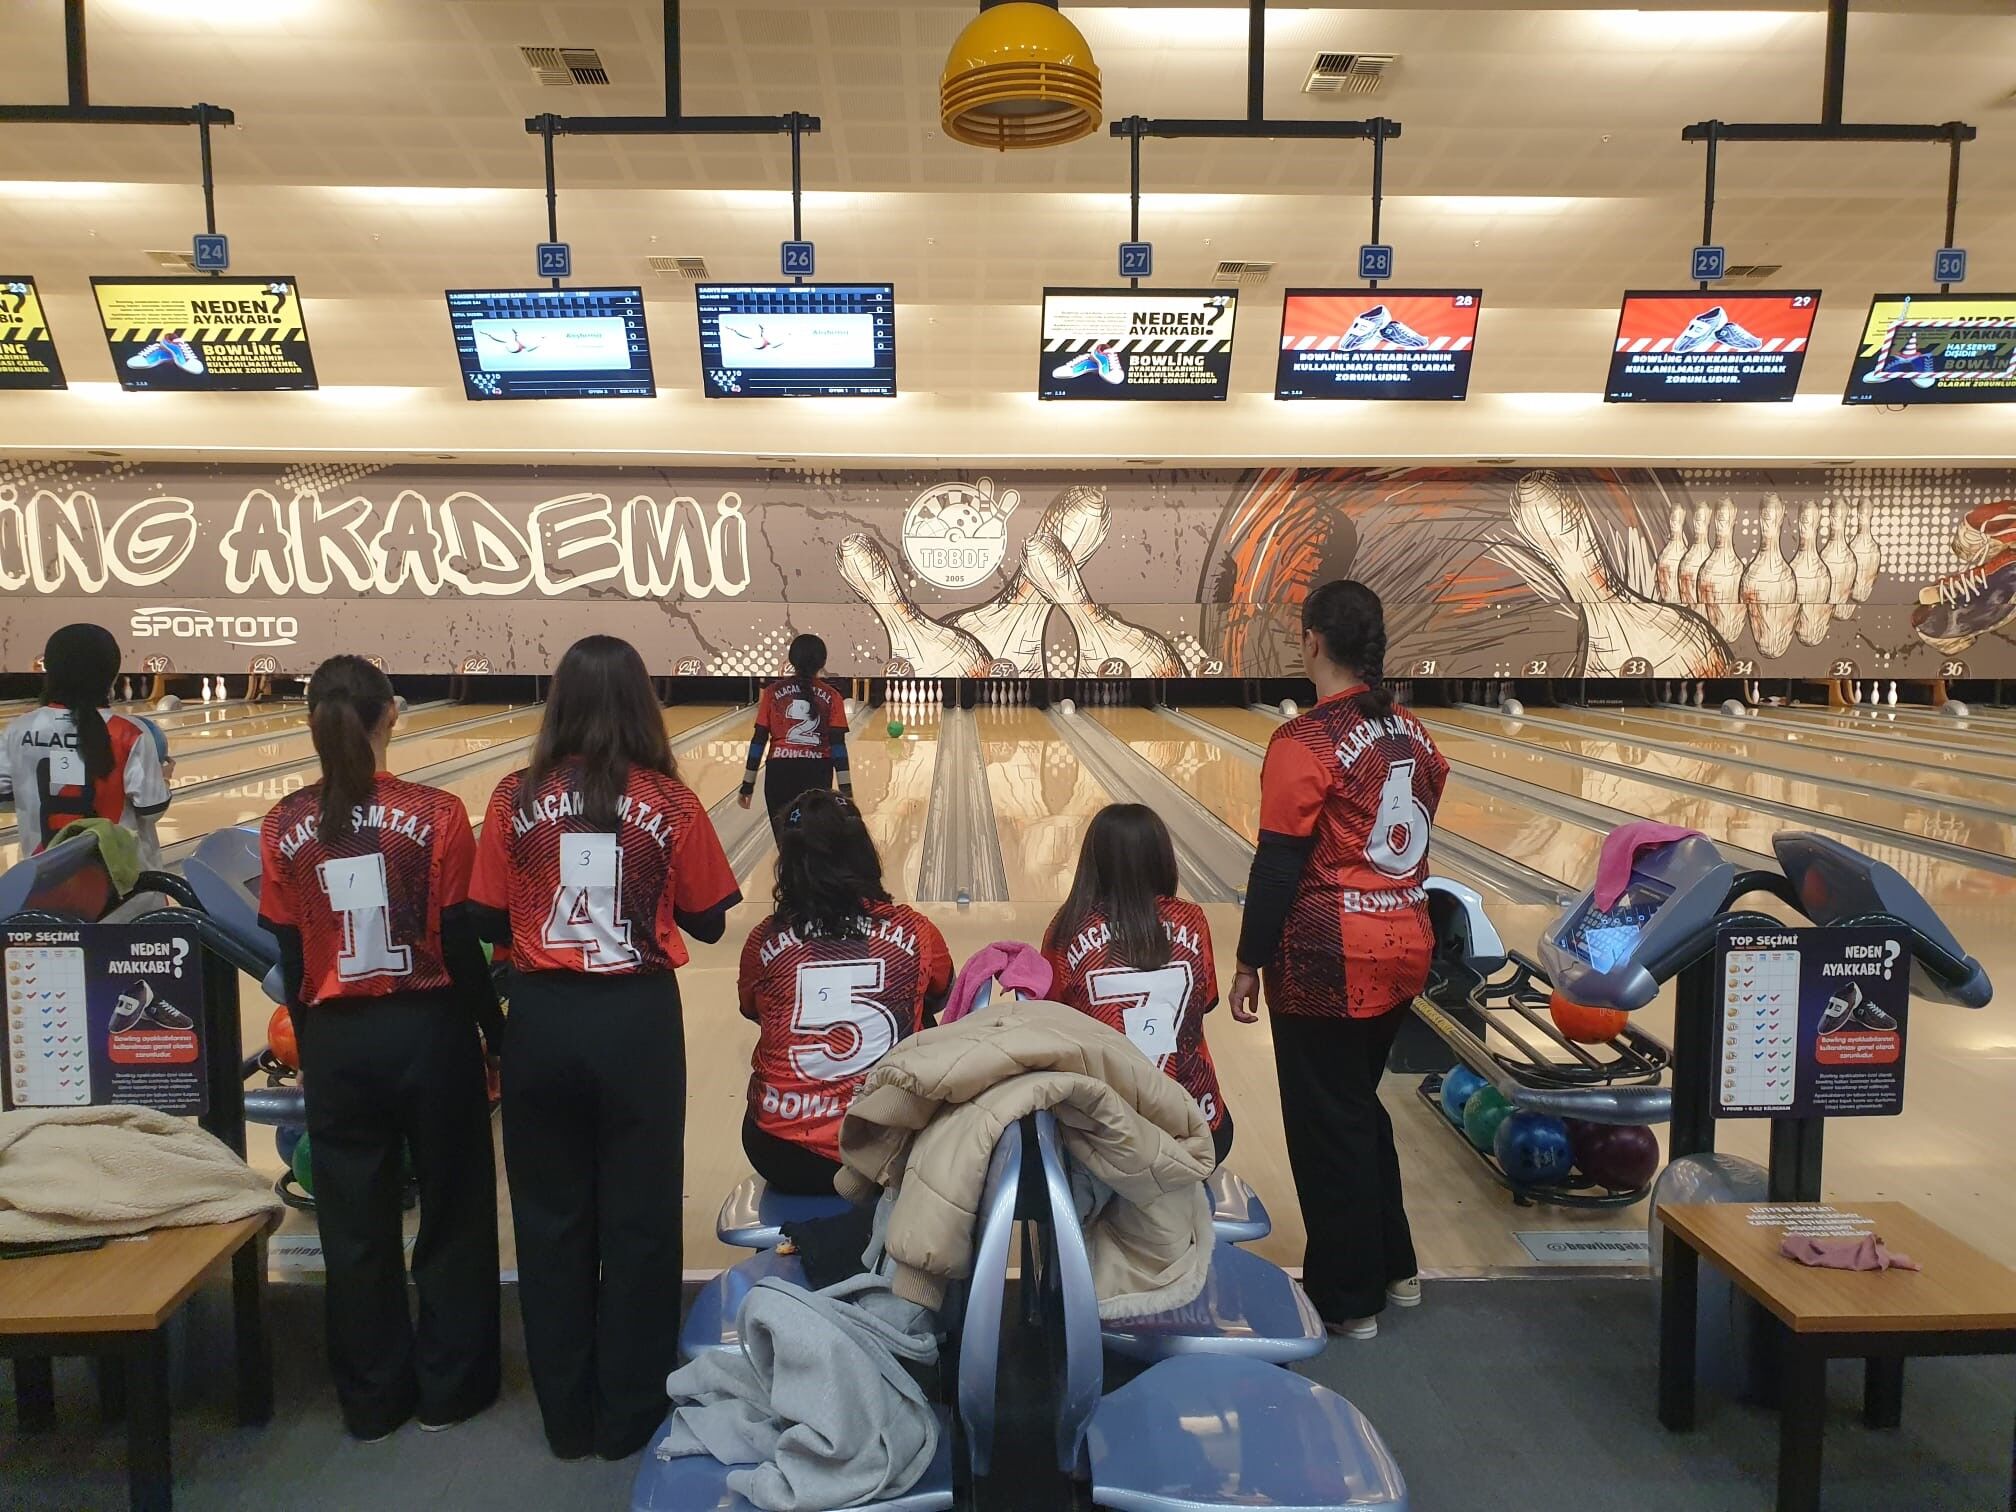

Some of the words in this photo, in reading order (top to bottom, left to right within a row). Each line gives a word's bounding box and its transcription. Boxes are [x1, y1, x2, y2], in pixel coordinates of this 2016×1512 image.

[200, 244, 223, 259] 24
[543, 253, 564, 268] 25
[787, 252, 808, 267] 26
[1125, 252, 1145, 268] 27
[1365, 255, 1386, 270] 28
[1697, 256, 1718, 270] 29
[1940, 258, 1959, 273] 30
[270, 283, 288, 293] 24
[1455, 296, 1473, 306] 28
[1792, 296, 1811, 307] 29
[1129, 326, 1205, 336] AYAKKABI
[1944, 357, 2009, 369] BOWLİN
[218, 488, 750, 598] AKADEMİ
[920, 549, 989, 569] TBBDF
[147, 657, 168, 672] 19
[254, 657, 275, 673] 20
[464, 658, 489, 674] 22
[678, 660, 701, 676] 24
[884, 661, 909, 676] 26
[989, 661, 1013, 676] 27
[1104, 661, 1123, 675] 28
[1204, 661, 1223, 675] 29
[1419, 660, 1436, 675] 31
[1528, 661, 1548, 674] 32
[1627, 661, 1646, 674] 33
[1734, 661, 1753, 675] 34
[1833, 661, 1853, 676] 35
[1942, 661, 1962, 676] 36
[785, 699, 822, 746] 2
[1335, 717, 1385, 768] ALAÇAM
[59, 756, 70, 770] 3
[1391, 796, 1400, 810] 2
[1363, 759, 1430, 879] 6
[579, 850, 592, 866] 3
[541, 845, 642, 972] 4
[315, 853, 413, 982] 1
[8, 932, 33, 942] TOP
[36, 930, 81, 944] SEÇİMİ
[1730, 936, 1753, 946] TOP
[1756, 934, 1798, 948] SEÇİMİ
[130, 942, 170, 956] NEDEN
[1845, 945, 1882, 958] NEDEN
[108, 960, 170, 974] AYAKKABI
[1822, 963, 1882, 976] AYAKKABI
[818, 987, 832, 1001] 5
[788, 958, 898, 1081] 5
[1085, 960, 1193, 1073] 7
[1142, 1018, 1158, 1036] 5
